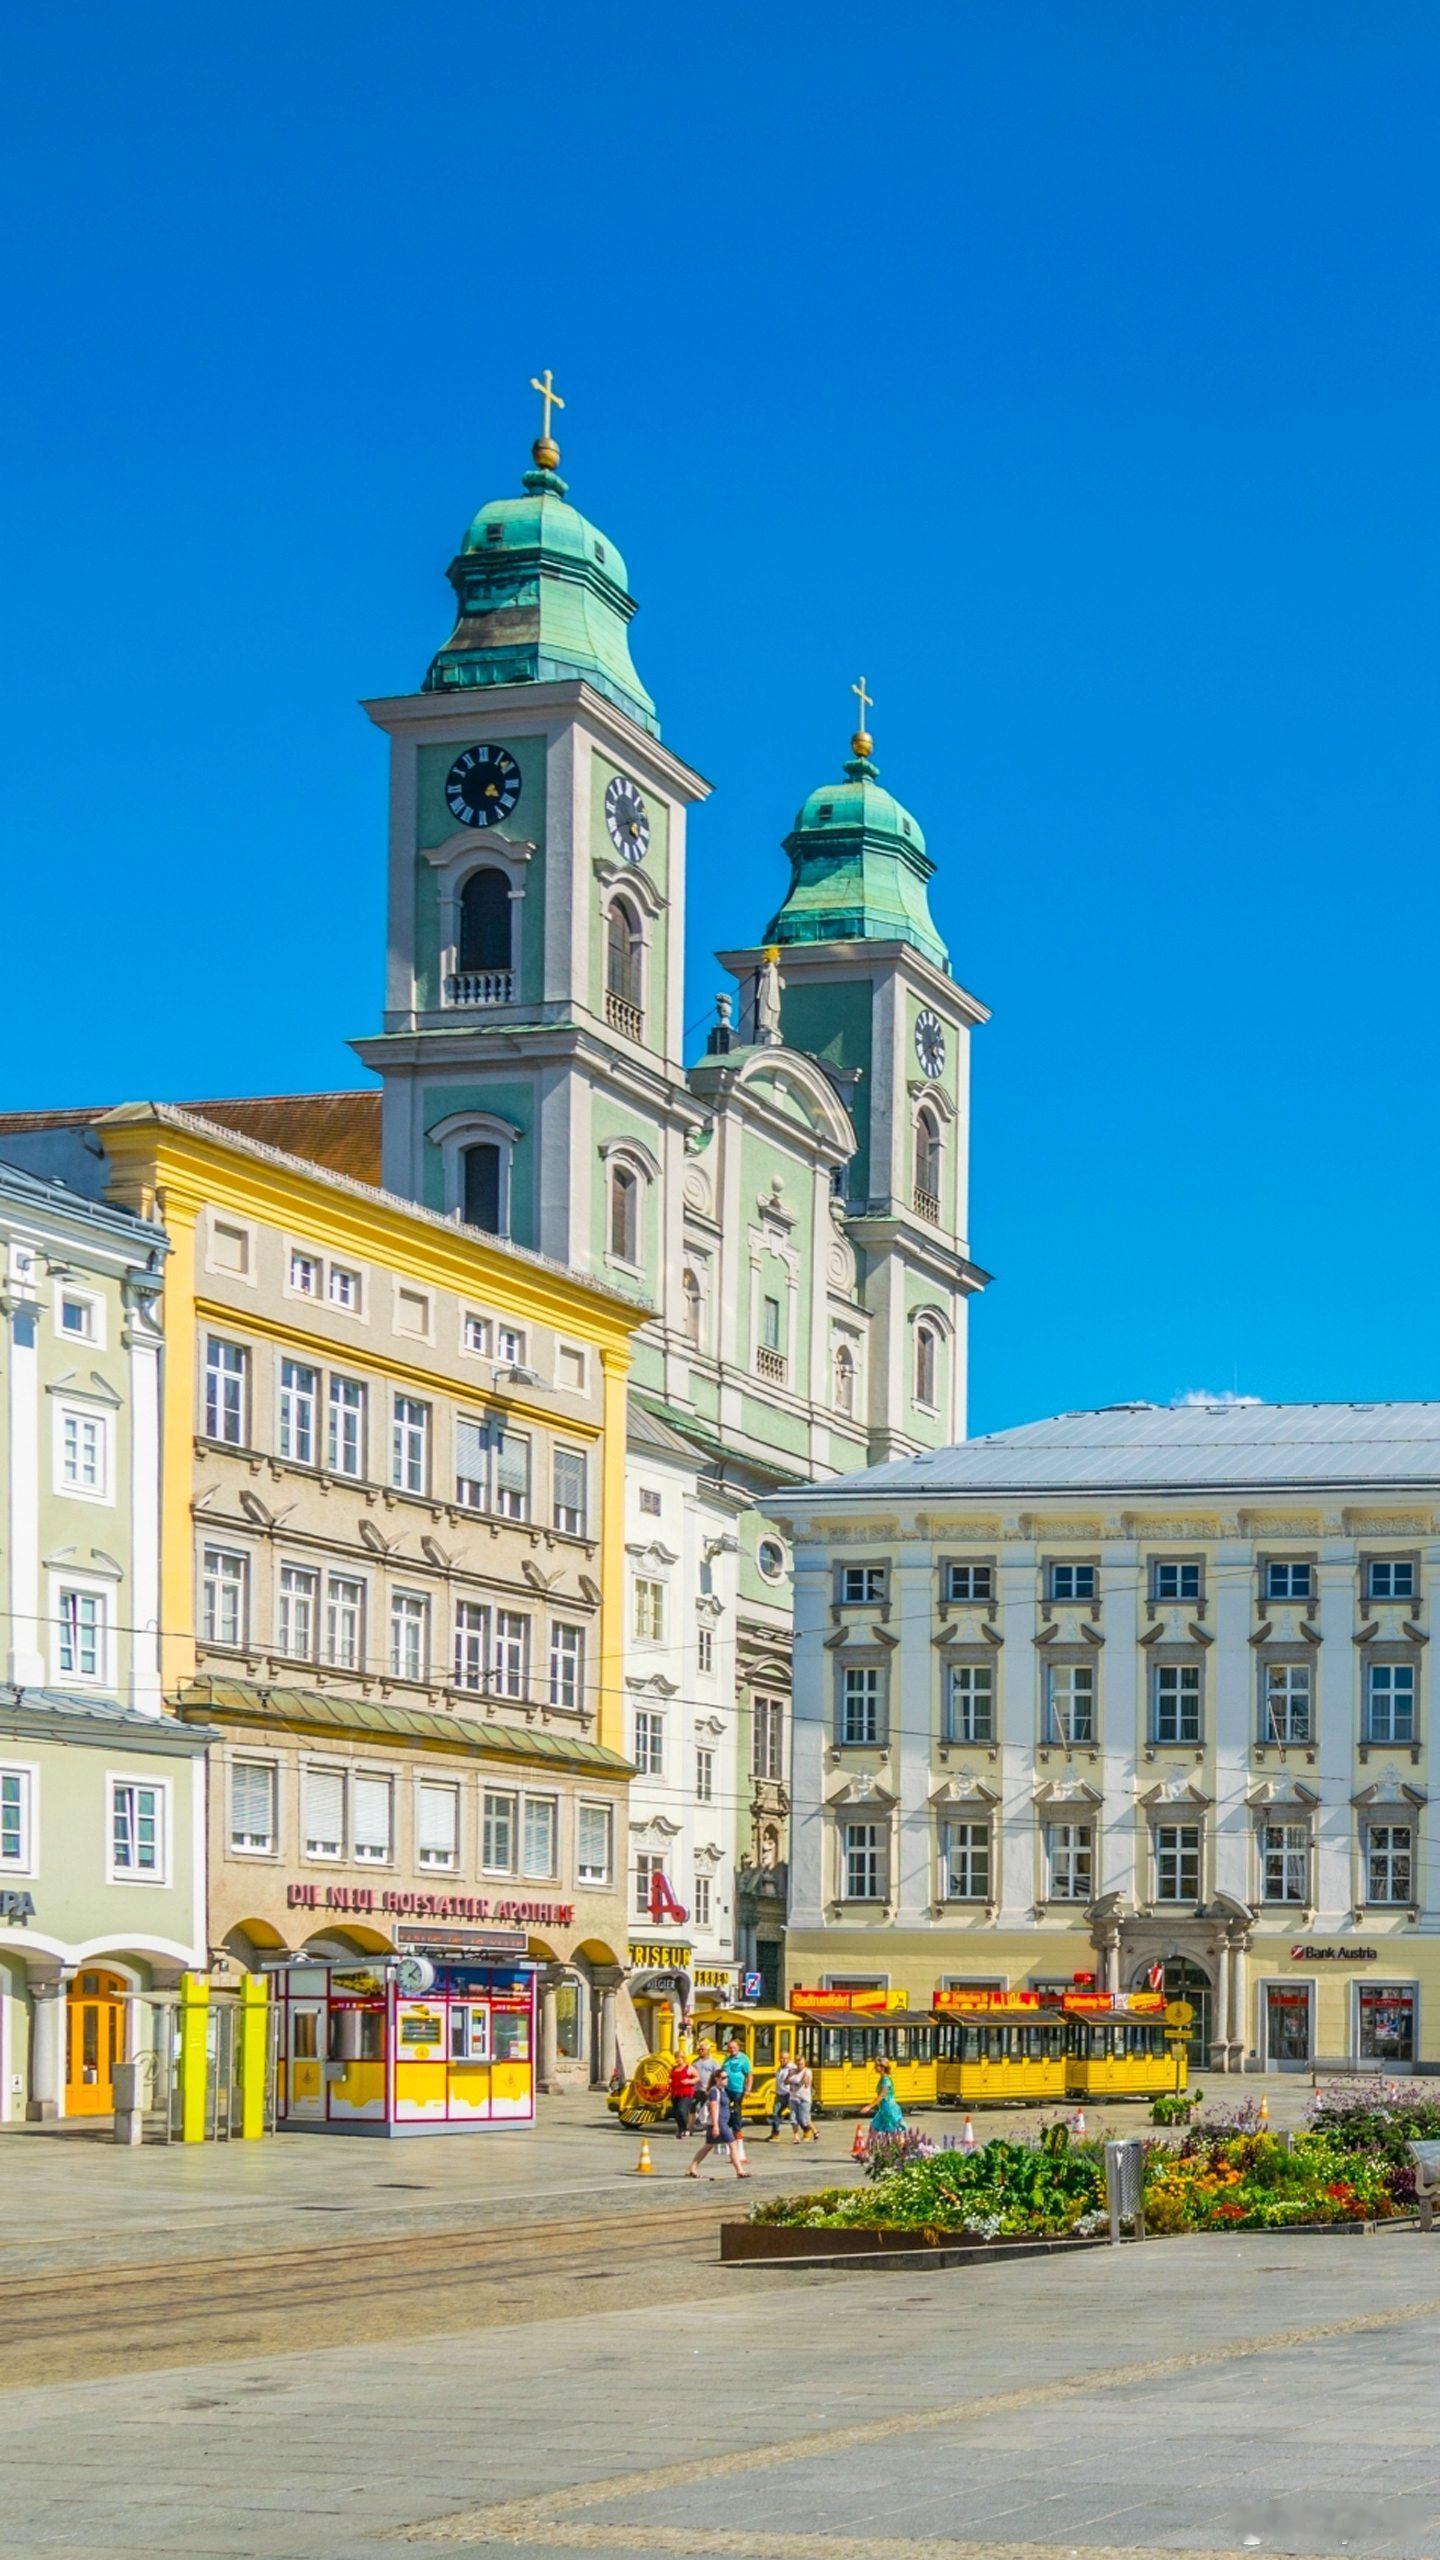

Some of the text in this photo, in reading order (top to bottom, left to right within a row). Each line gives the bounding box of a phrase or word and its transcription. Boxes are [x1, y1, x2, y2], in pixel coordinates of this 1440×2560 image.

[287, 1884, 321, 1906] DIE
[1306, 1946, 1377, 1959] Bank Austria
